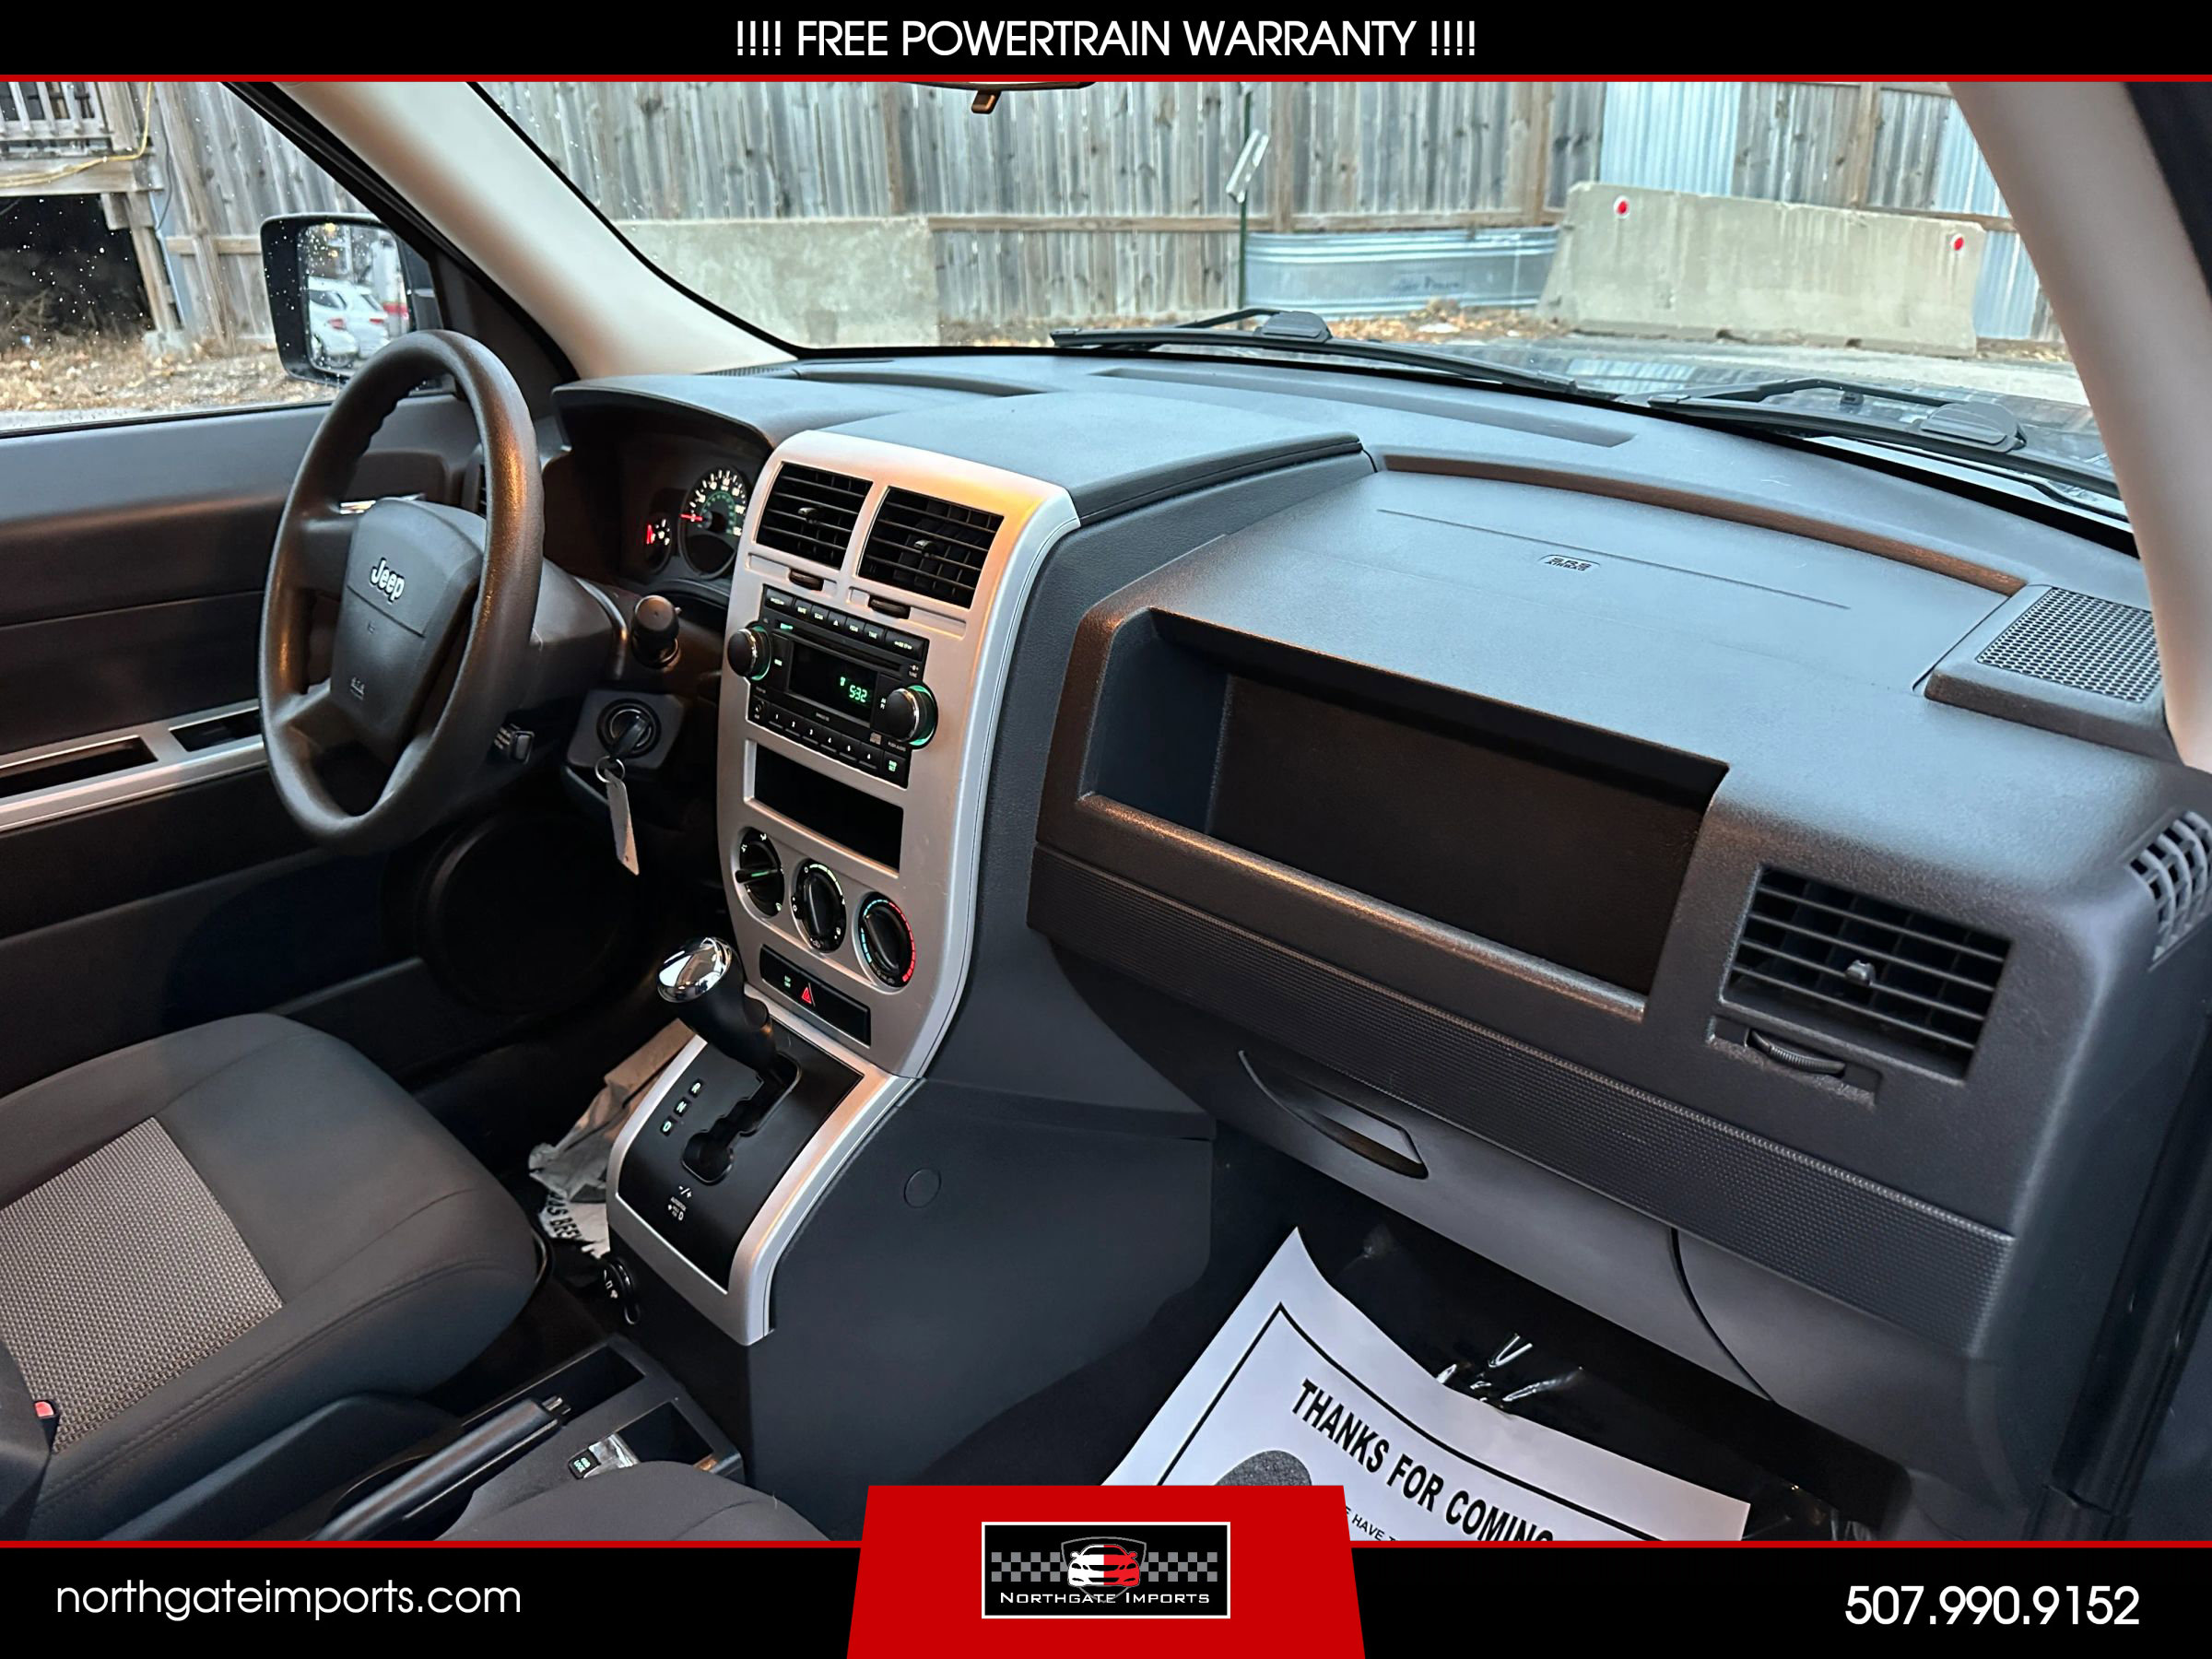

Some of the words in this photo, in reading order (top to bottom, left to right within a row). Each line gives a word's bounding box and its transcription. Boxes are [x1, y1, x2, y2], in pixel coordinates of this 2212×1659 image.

[370, 558, 406, 602] Jeep
[1291, 1377, 1390, 1474] THANKS
[1385, 1453, 1444, 1512] FOR
[1351, 1513, 1385, 1541] HAVE
